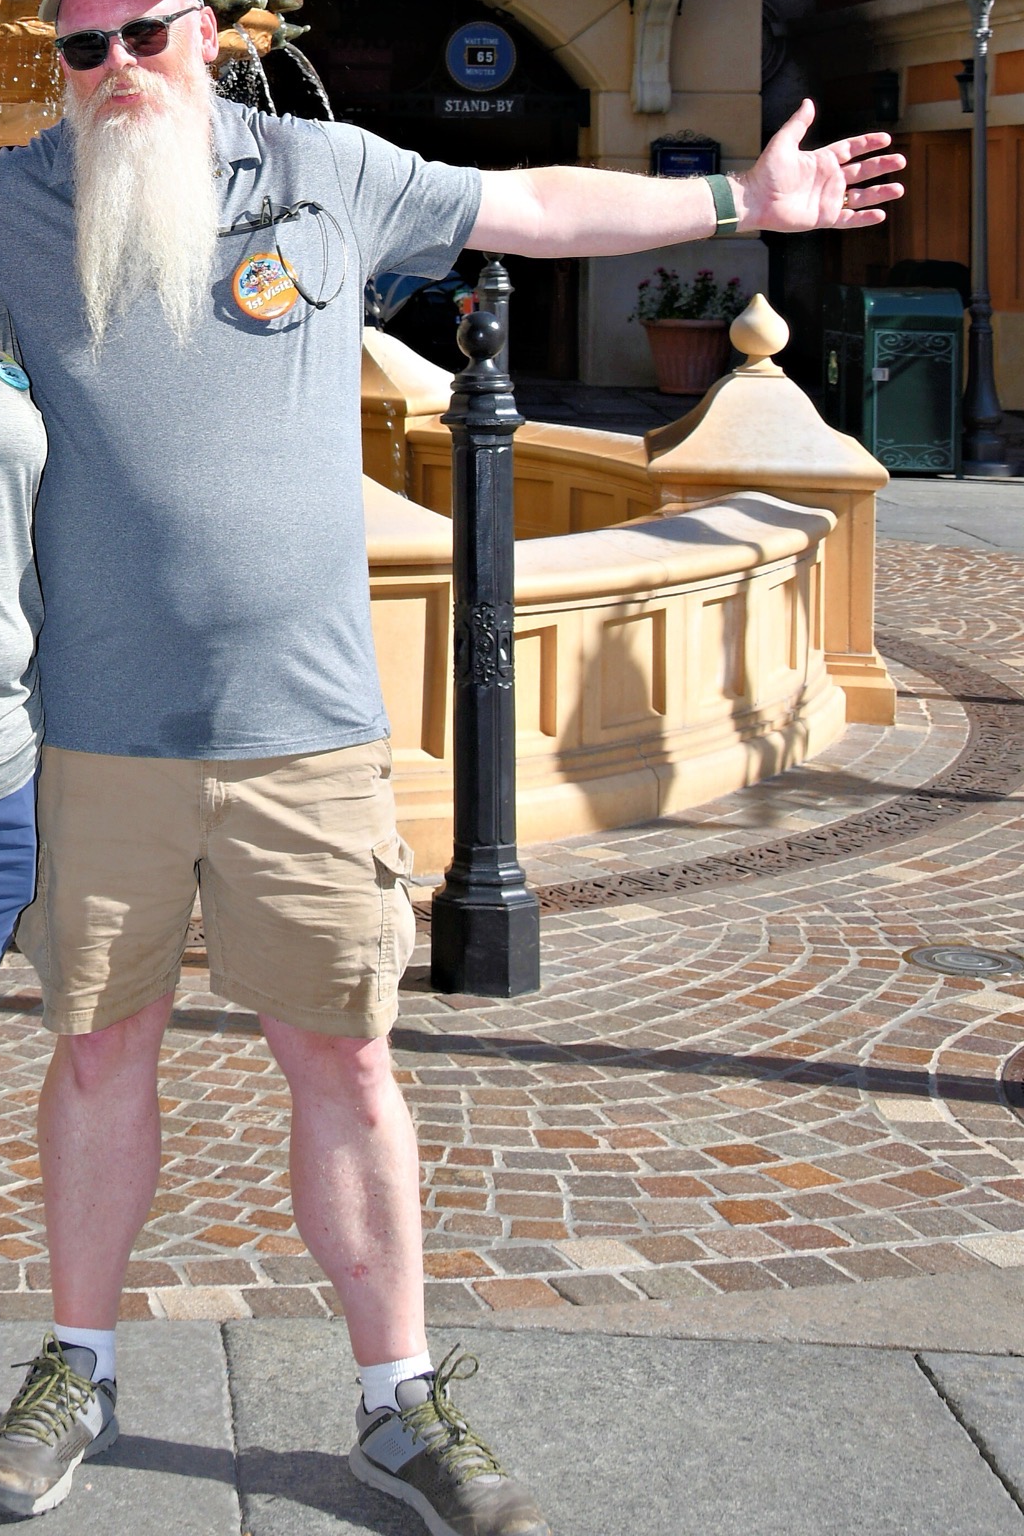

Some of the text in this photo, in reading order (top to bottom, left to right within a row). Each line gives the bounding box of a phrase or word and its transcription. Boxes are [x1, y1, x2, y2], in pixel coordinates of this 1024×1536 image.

[477, 52, 493, 62] 65
[444, 99, 514, 112] STAND-BY
[245, 296, 263, 310] 1st
